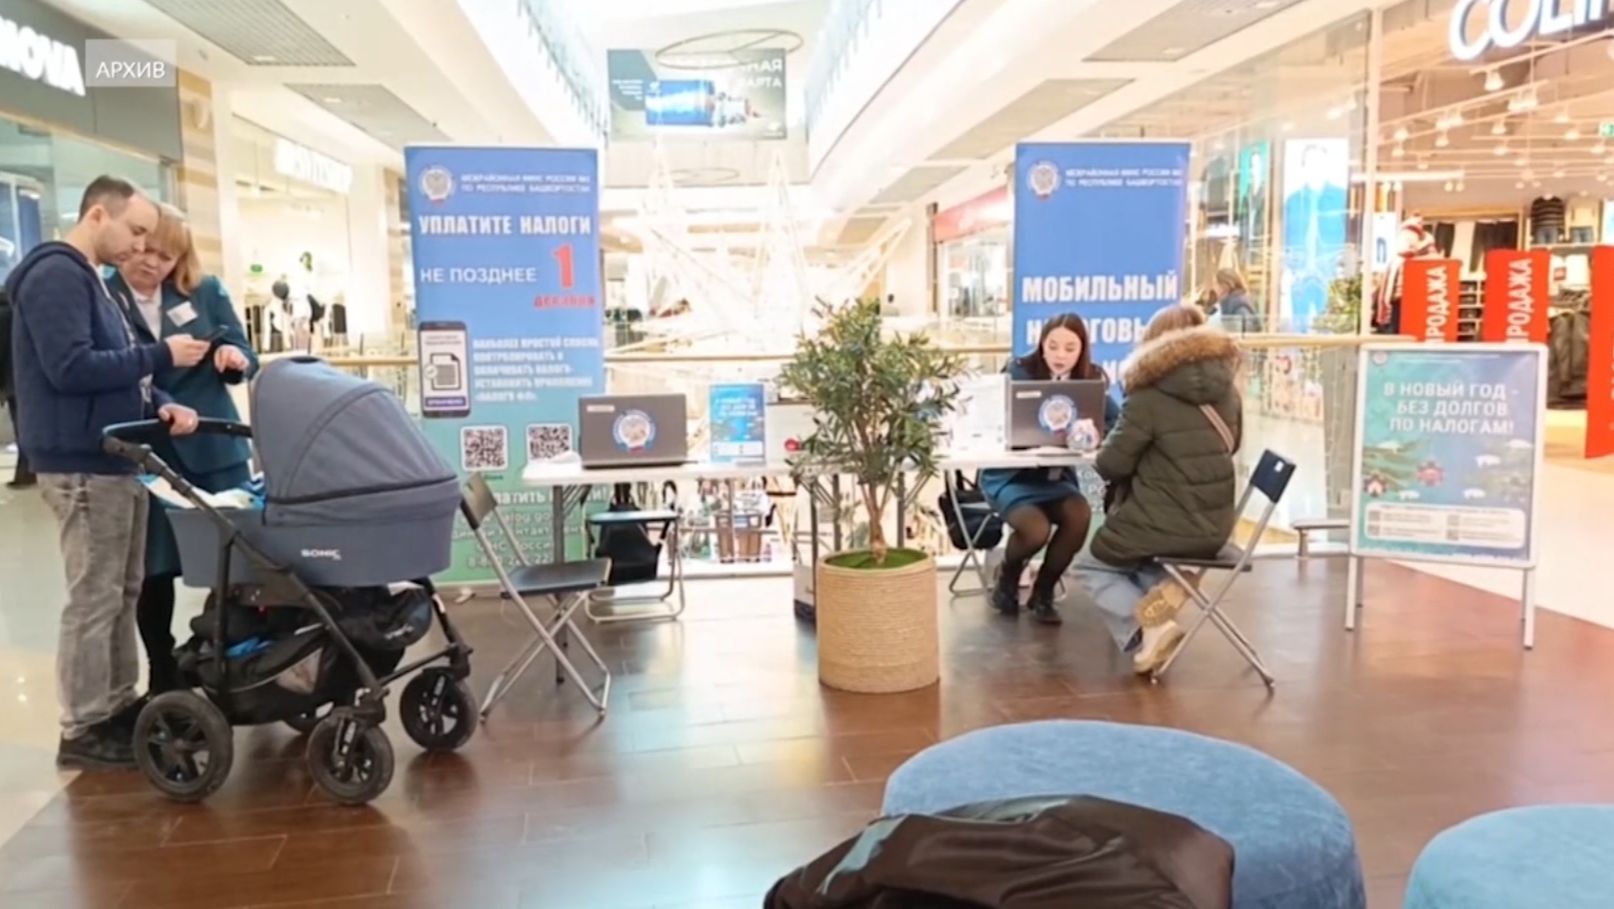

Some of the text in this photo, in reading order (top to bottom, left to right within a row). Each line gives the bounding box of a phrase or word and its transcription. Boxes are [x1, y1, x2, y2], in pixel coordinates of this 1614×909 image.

[419, 215, 591, 234] УПЛАТИТЕ НАЛОГИ
[420, 268, 537, 284] НЕ ПОЗДНЕЕ
[552, 243, 576, 290] 1
[1022, 270, 1178, 303] МОБИЛЬНЫЙ
[1425, 266, 1450, 343] РОДАЖА
[1506, 258, 1535, 343] РОДАЖА
[1384, 383, 1394, 396] В
[1400, 379, 1464, 396] НОВЫЙ
[1470, 384, 1506, 400] ГОД
[1397, 401, 1509, 417] БЕЗ ДОЛГОВ
[1390, 419, 1515, 434] ПО НАЛОГАМ!
